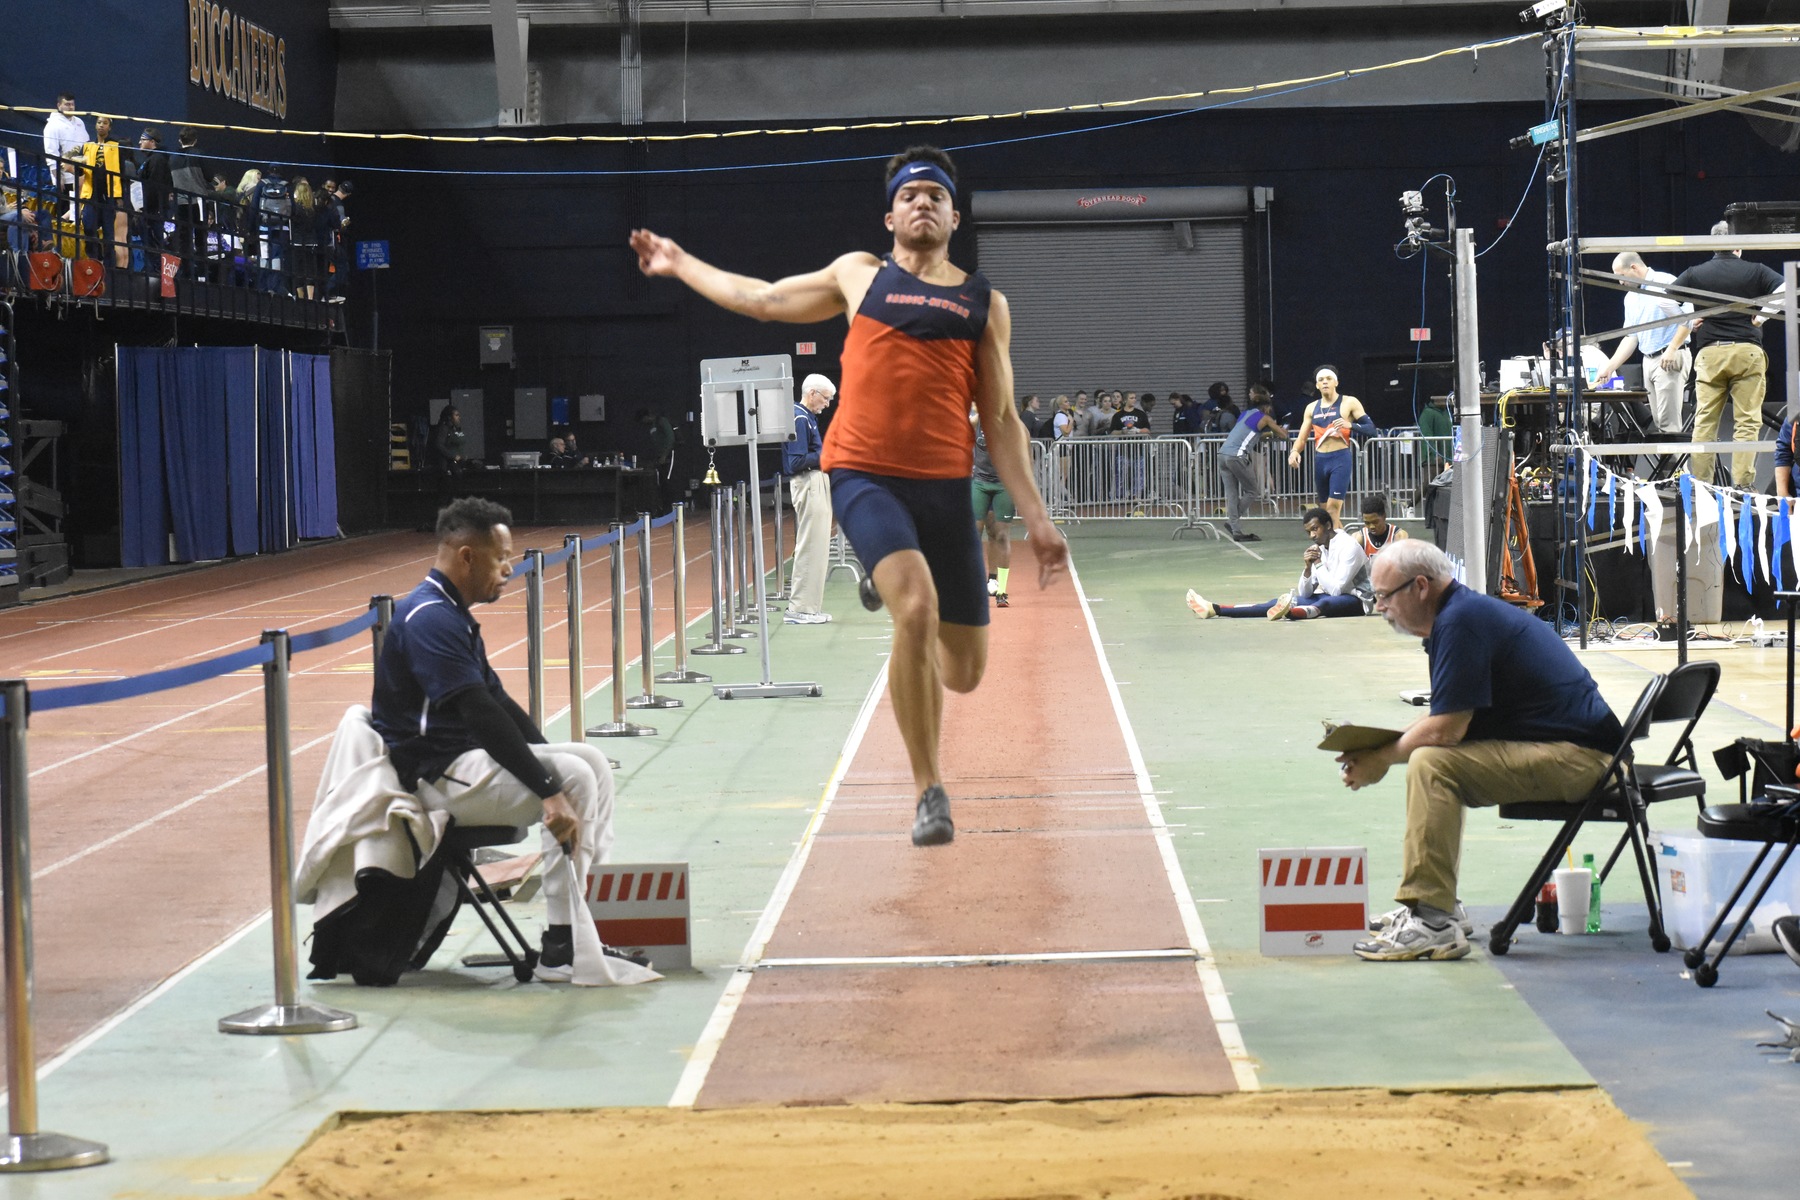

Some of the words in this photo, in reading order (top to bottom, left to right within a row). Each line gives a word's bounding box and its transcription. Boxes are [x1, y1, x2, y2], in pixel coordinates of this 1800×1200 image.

[188, 0, 287, 119] BUCCANEERS
[1084, 195, 1121, 207] OVERHEAD
[1121, 195, 1141, 206] DOOR
[799, 343, 813, 354] EXIT
